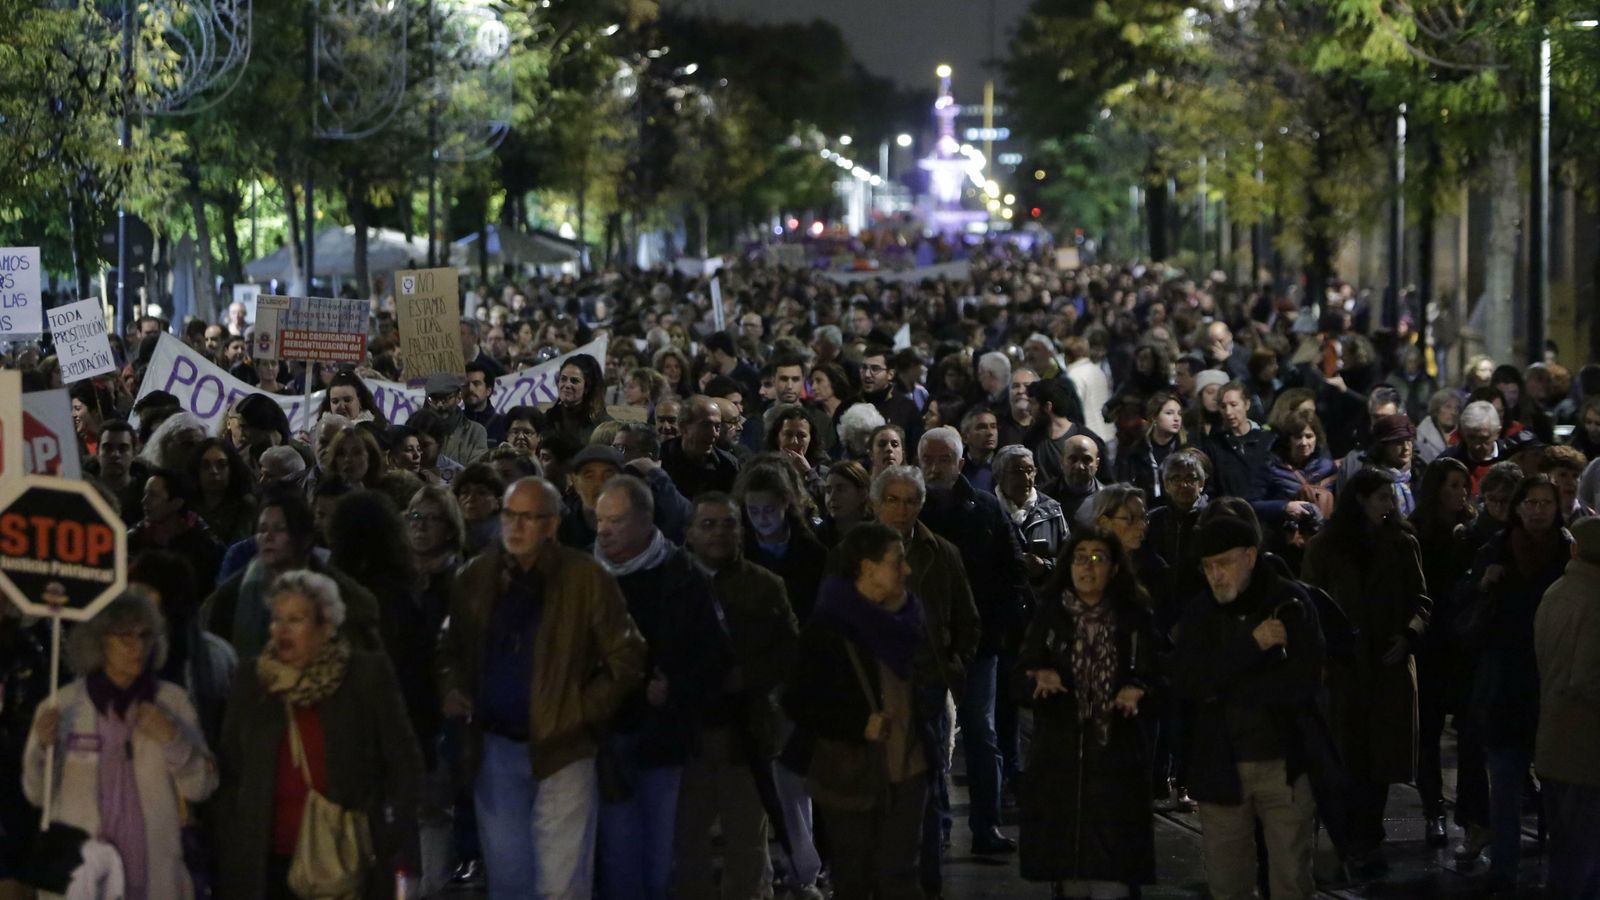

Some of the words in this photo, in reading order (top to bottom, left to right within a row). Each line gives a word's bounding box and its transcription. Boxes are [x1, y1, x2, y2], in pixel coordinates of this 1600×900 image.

[0, 256, 30, 271] MOS
[417, 271, 435, 294] NO
[3, 293, 27, 309] LAS
[408, 296, 447, 317] ESTAMOS
[49, 309, 83, 328] TODA
[415, 316, 442, 336] TODAS
[284, 331, 294, 339] NO
[301, 332, 308, 340] la
[355, 336, 362, 344] y
[284, 339, 349, 351] MERCANTILIZACIÓN
[349, 343, 361, 352] del
[61, 349, 110, 379] EXPLOTACIÓN
[283, 349, 308, 359] cuerpo
[309, 349, 319, 358] de
[319, 350, 331, 359] las
[331, 352, 361, 361] mujeres
[164, 355, 248, 419] PO
[0, 513, 114, 566] STOP
